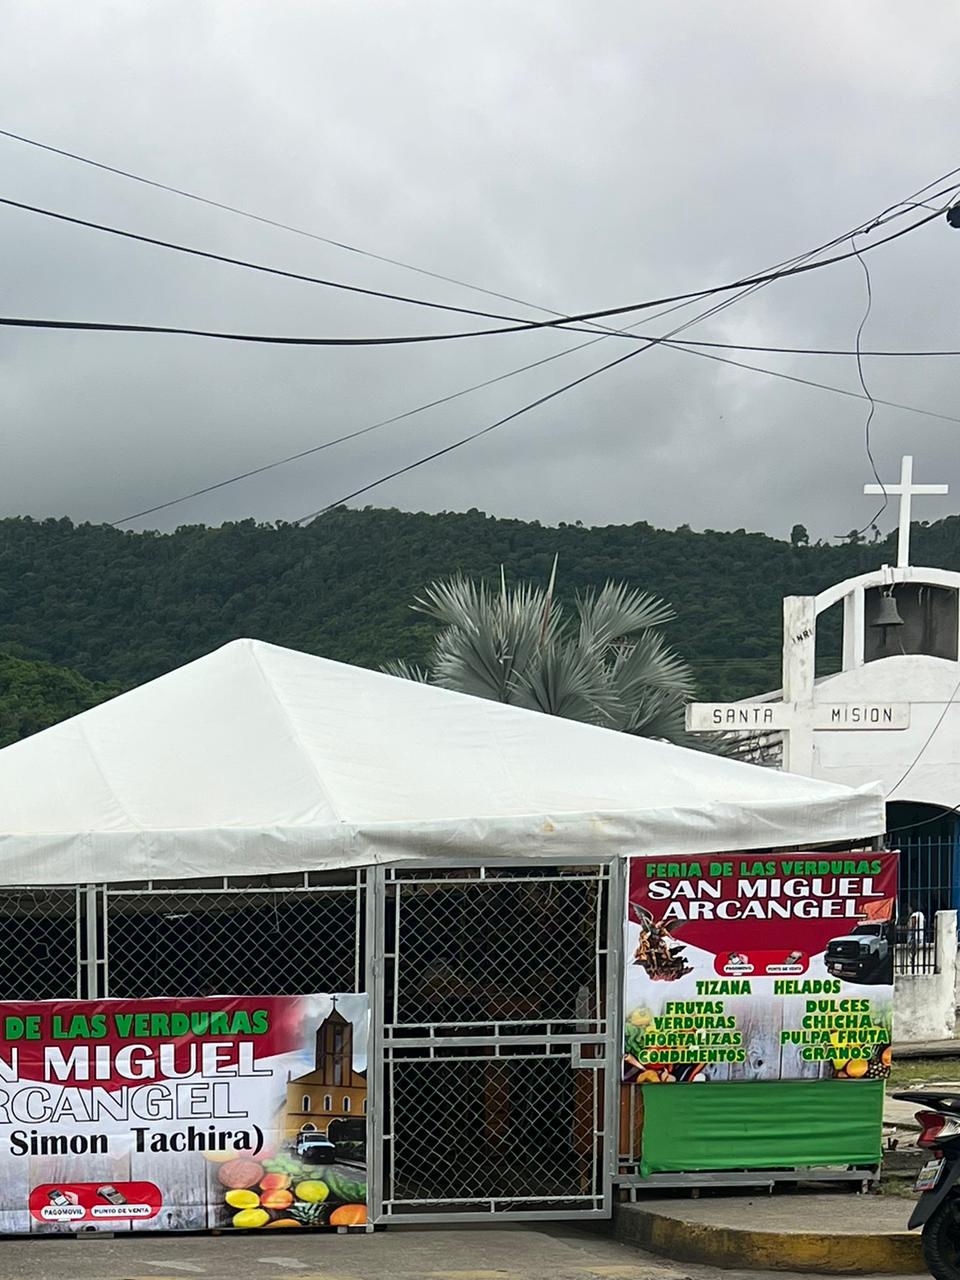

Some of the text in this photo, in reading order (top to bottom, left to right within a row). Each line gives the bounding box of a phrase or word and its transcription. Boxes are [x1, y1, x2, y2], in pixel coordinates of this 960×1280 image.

[713, 708, 892, 724] SANTA MISION
[646, 859, 882, 877] FERIA DE LAS VERDURAS
[647, 877, 885, 899] SAN MIGUEL
[662, 899, 869, 920] ARCANGEL
[695, 980, 752, 995] TIZANA
[774, 980, 841, 995] HELADOS
[665, 1001, 724, 1015] FRUTAS
[805, 1000, 870, 1013] DULCES
[5, 1015, 41, 1040] DE
[52, 1014, 107, 1039] LAS
[114, 1010, 270, 1038] VERDURAS
[653, 1015, 736, 1030] VERDURAS
[802, 1014, 873, 1029] CHICHA
[644, 1031, 742, 1046] HORTALIZAS
[781, 1029, 890, 1045] PULPA FRUTA
[43, 1041, 273, 1082] MIGUEL
[639, 1048, 745, 1064] CONDIMENTOS
[802, 1046, 872, 1061] GRANOS
[10, 1129, 109, 1156] Simon
[130, 1124, 265, 1154] Tachira)
